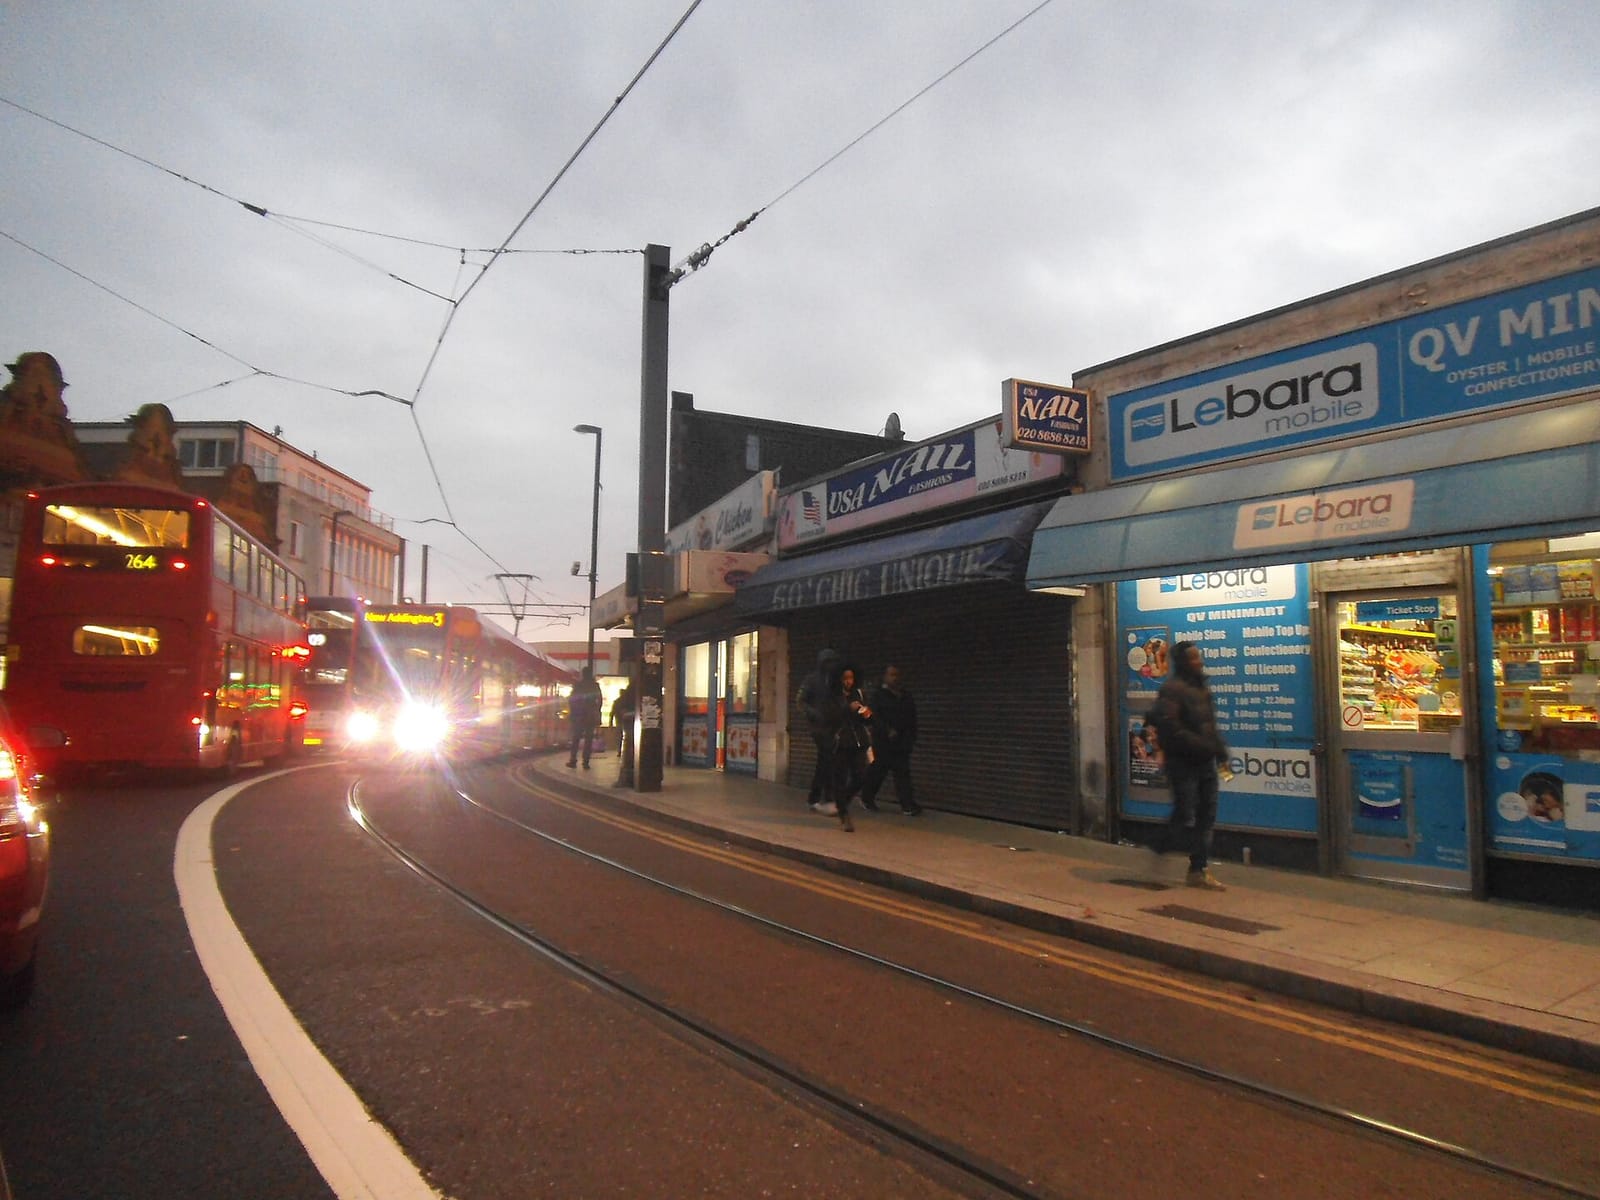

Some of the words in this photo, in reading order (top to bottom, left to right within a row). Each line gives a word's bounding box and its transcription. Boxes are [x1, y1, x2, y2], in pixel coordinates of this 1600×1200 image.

[1408, 316, 1481, 372] QV
[1446, 361, 1509, 383] OYSTER
[1527, 341, 1595, 367] MOBILE
[1170, 360, 1363, 434] Lebara
[1019, 395, 1083, 424] NAIL
[1265, 398, 1363, 435] mobile
[1018, 427, 1037, 439] 020
[828, 482, 866, 514] USA
[868, 443, 972, 503] NAIL
[908, 472, 953, 495] FASHIONS
[1276, 491, 1393, 529] Lebara
[1333, 514, 1389, 532] mobile
[125, 554, 156, 569] 264
[1180, 566, 1268, 592] Lebara
[1224, 587, 1268, 600] mobile
[1187, 611, 1206, 622] QV
[1208, 605, 1286, 621] MINIMART
[1414, 605, 1436, 613] Stop
[432, 612, 445, 627] 3
[1204, 629, 1227, 640] Sims
[1242, 626, 1275, 638] Mobile
[1275, 625, 1294, 637] Top
[1203, 648, 1219, 658] Top
[1258, 663, 1297, 675] Licence
[1244, 683, 1280, 692] Hours
[1229, 753, 1311, 780] ebara
[1264, 779, 1312, 794] mobile
